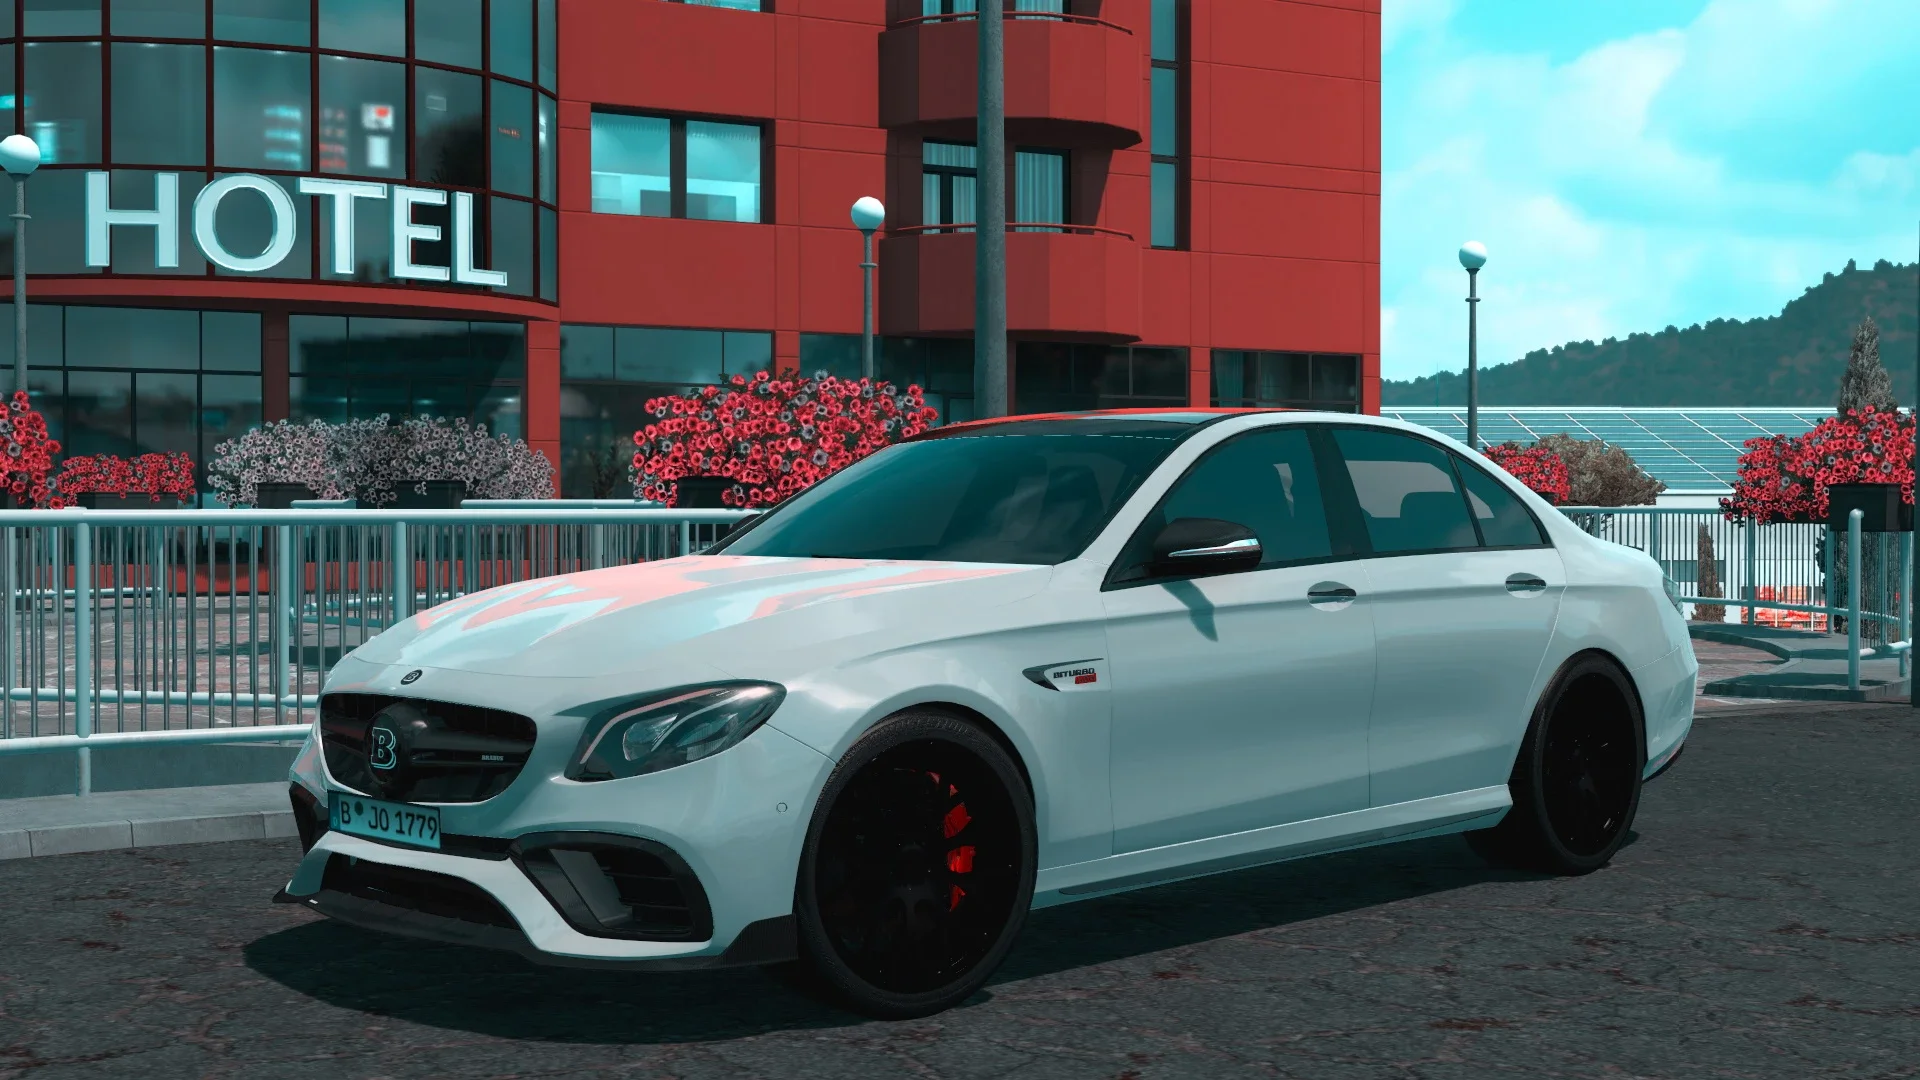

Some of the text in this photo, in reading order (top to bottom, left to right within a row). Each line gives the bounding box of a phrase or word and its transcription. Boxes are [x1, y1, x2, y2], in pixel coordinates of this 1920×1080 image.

[85, 171, 508, 287] HOTEL
[1053, 667, 1095, 678] BITURBO
[371, 726, 397, 769] B
[341, 801, 438, 840] B JO 1779
